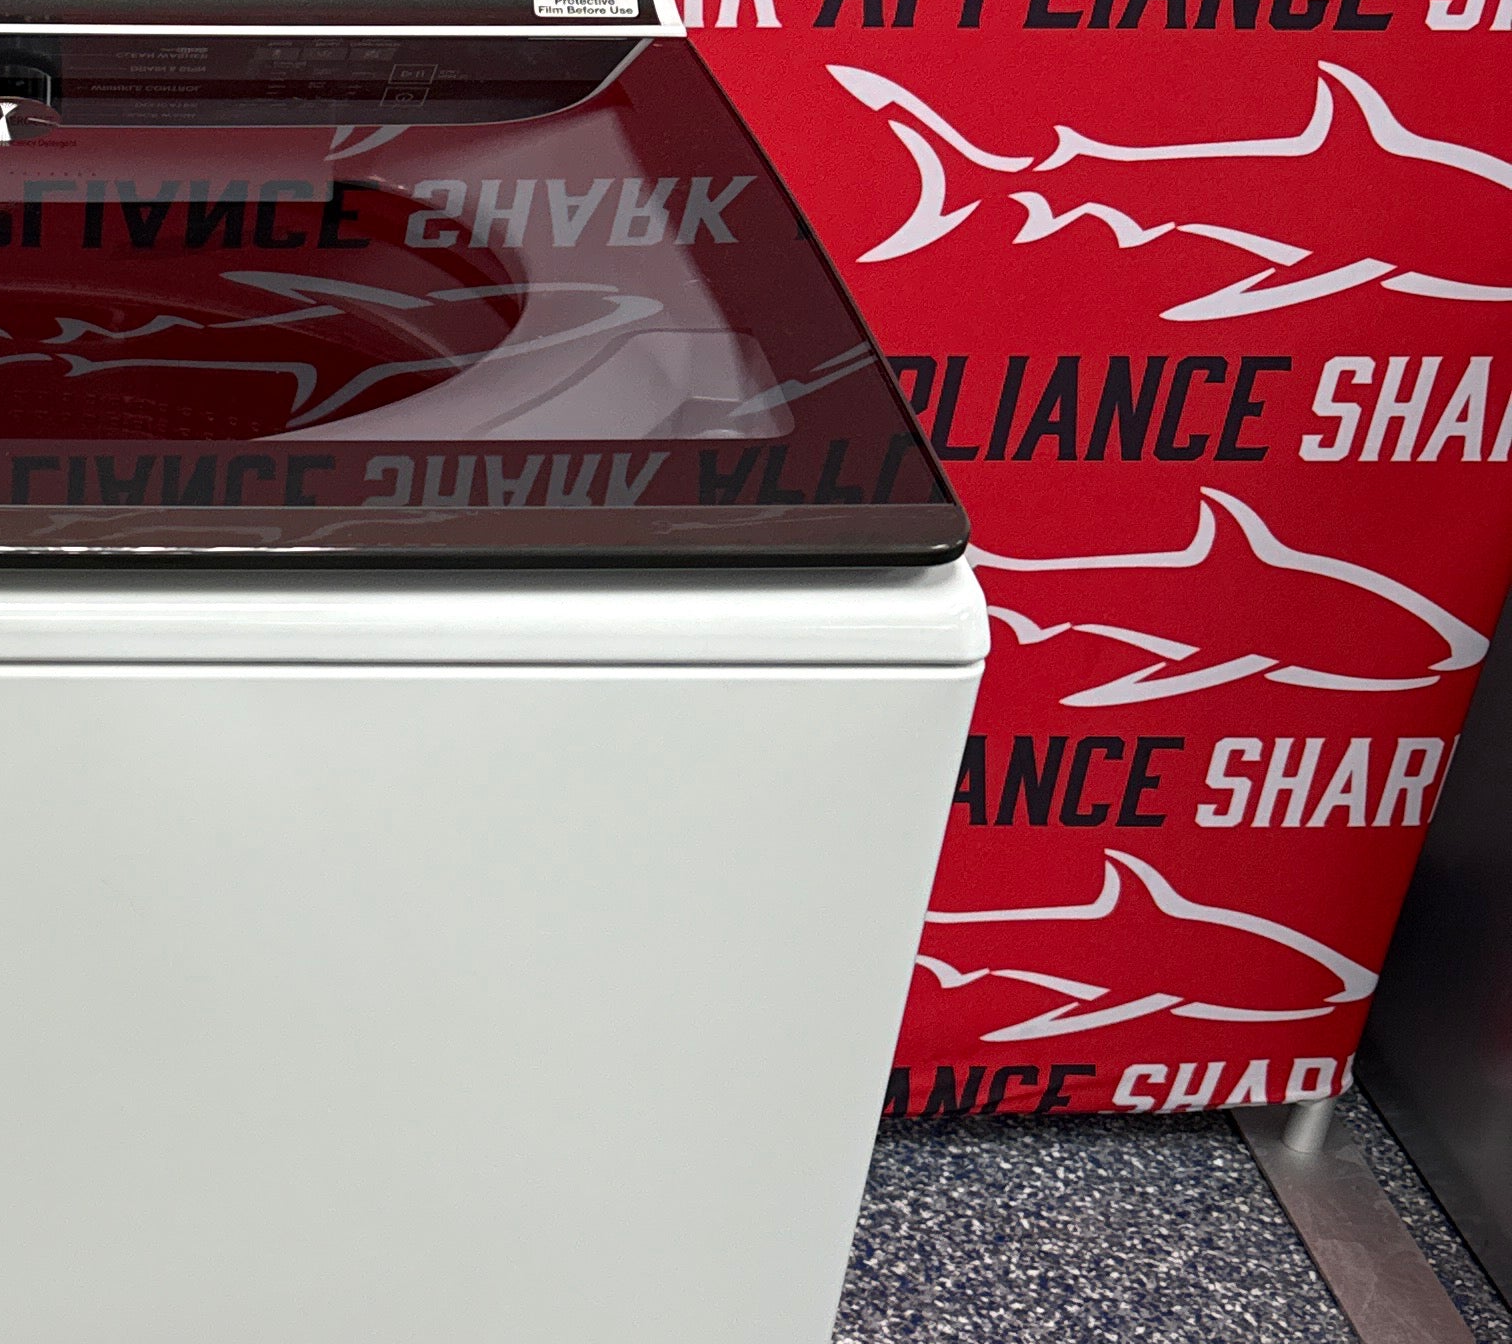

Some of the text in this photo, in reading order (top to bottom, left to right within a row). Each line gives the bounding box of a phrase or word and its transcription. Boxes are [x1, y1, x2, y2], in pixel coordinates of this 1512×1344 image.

[538, 6, 633, 15] Film Before Use
[1299, 355, 1512, 462] SHA
[1195, 734, 1461, 828] SHAR
[1111, 1054, 1356, 1116] SHAR
